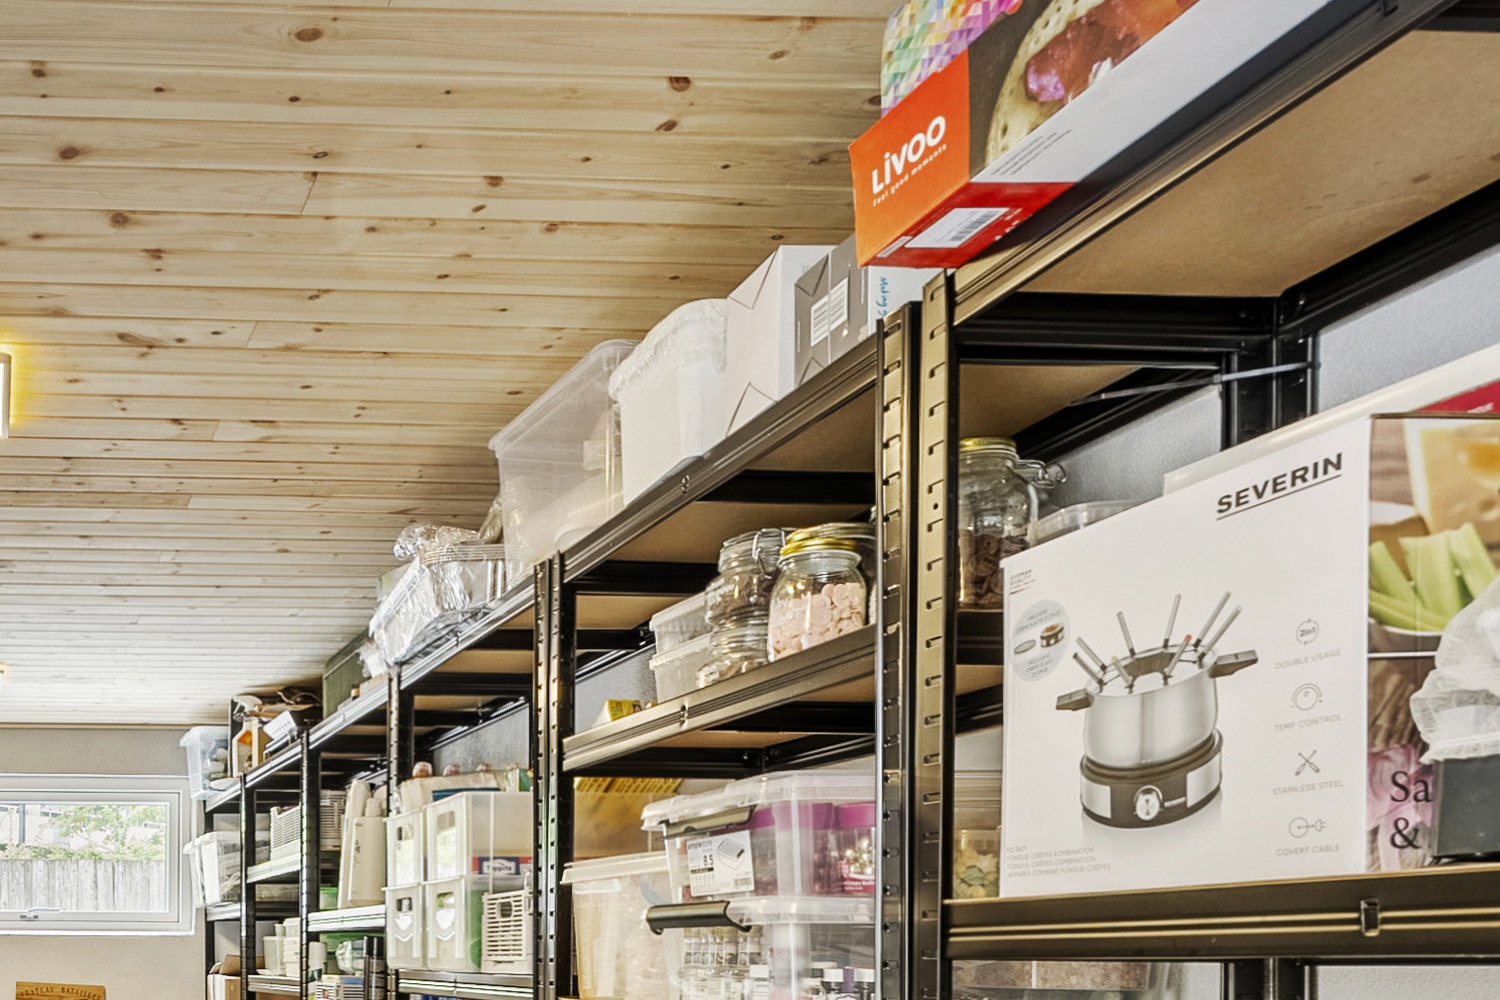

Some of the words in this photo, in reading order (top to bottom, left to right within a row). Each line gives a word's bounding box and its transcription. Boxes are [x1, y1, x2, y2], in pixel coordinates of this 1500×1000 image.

[1217, 452, 1343, 515] SEVERIN
[1274, 656, 1308, 670] DOUBLE
[1311, 648, 1341, 662] USAGE
[1274, 722, 1296, 732] TEMP
[1298, 714, 1342, 728] CONTROL
[1272, 783, 1317, 796] STAINLESS
[1317, 780, 1346, 790] STEEL
[1390, 770, 1433, 803] Sa
[1390, 817, 1421, 850] &
[1276, 846, 1309, 857] COVERT
[1311, 843, 1341, 854] CABLE
